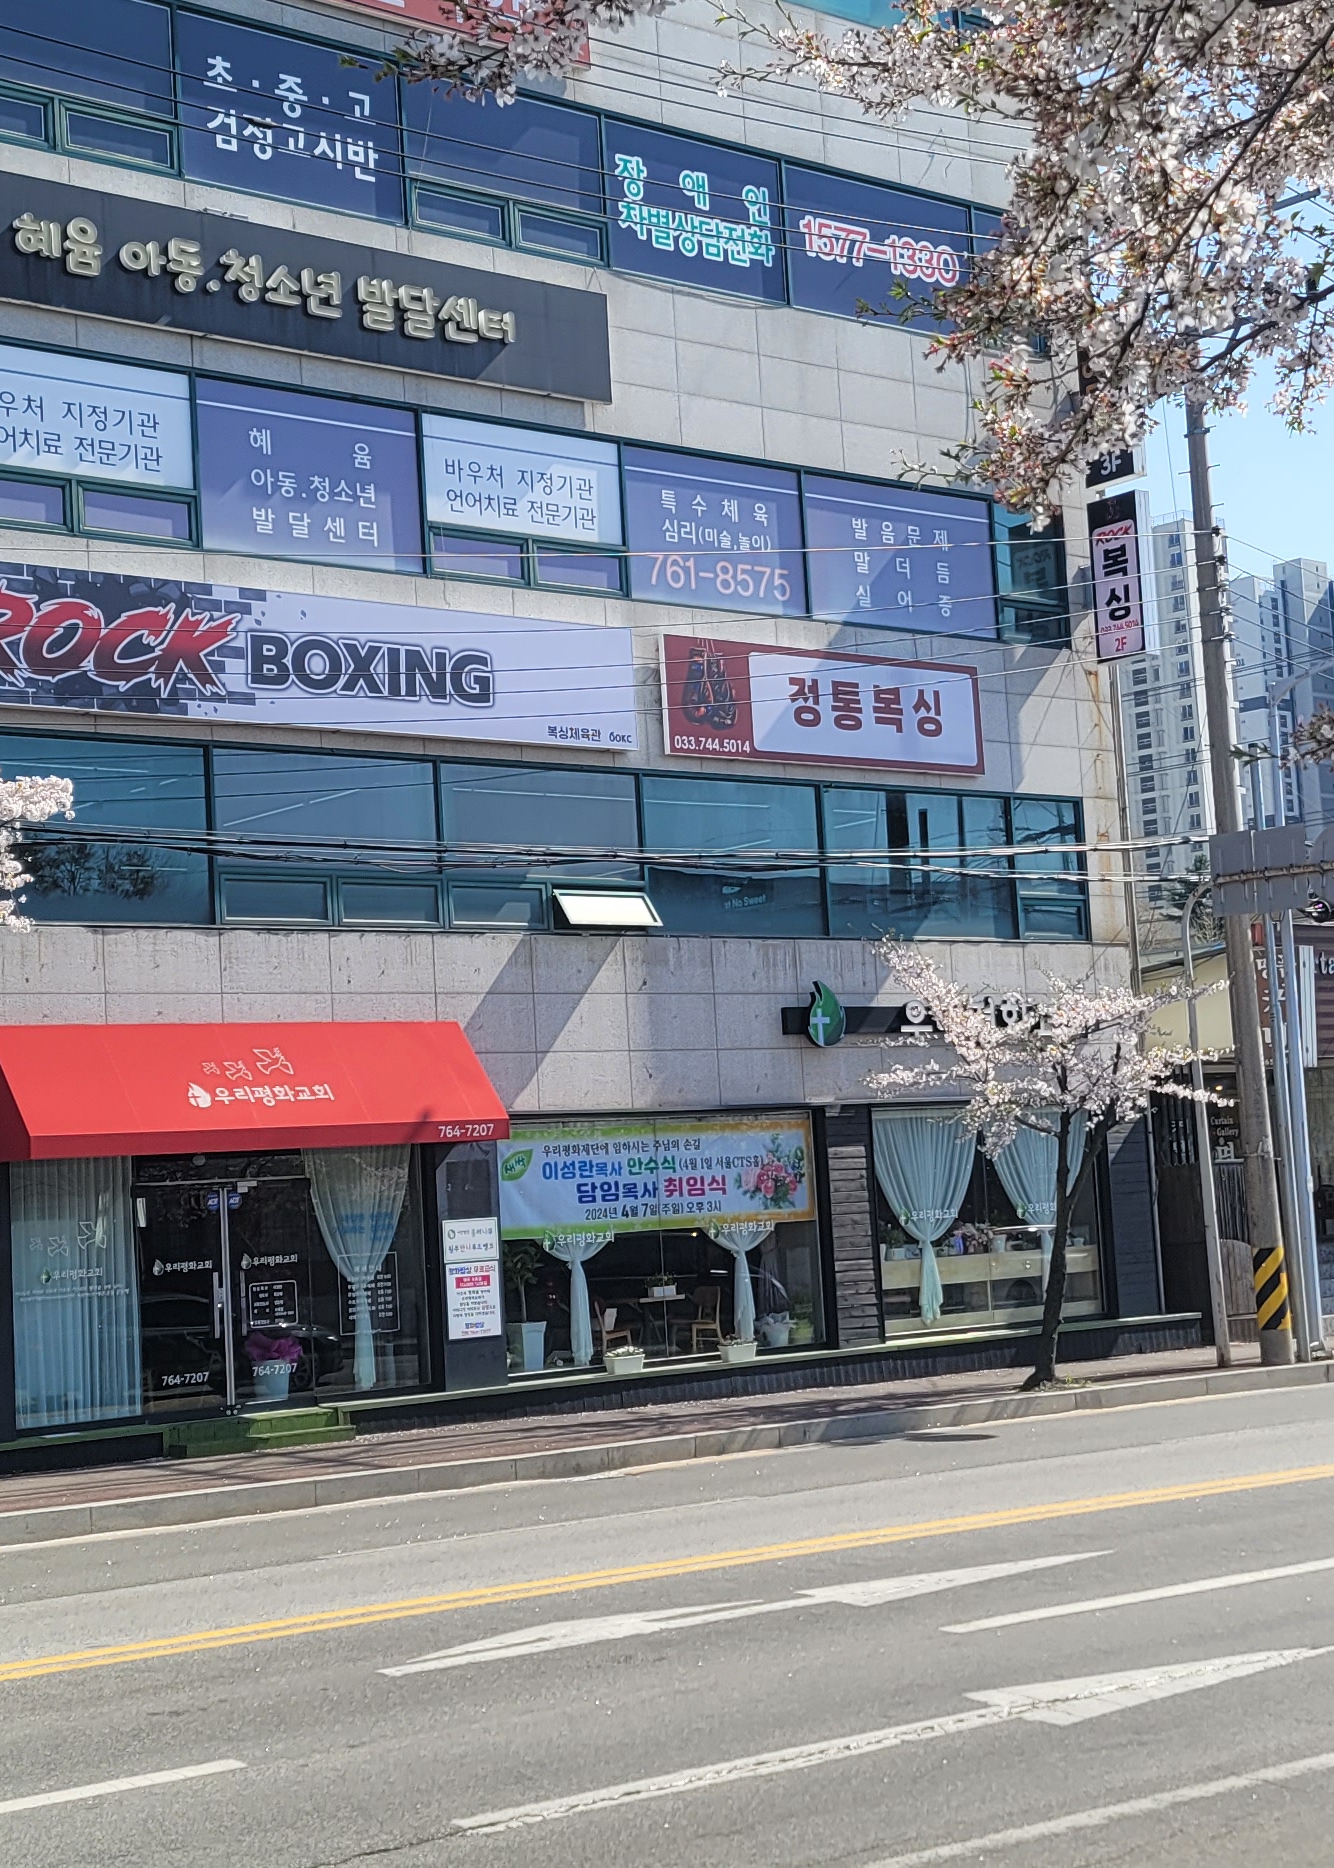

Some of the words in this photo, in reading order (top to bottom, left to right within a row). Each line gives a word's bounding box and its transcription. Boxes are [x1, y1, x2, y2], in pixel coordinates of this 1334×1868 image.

[206, 106, 380, 183] 검정고시반
[618, 198, 776, 268] 차별상담전화
[798, 215, 960, 287] 1577-1330
[357, 275, 517, 345] 발달센터
[61, 402, 160, 440] 지정기관
[73, 436, 163, 473] 전문기관
[1099, 454, 1122, 476] 3F
[250, 468, 377, 509] 아동.청소년
[444, 458, 505, 485] 바우처
[516, 469, 594, 503] 지정기관
[446, 488, 520, 520] 언어치료
[527, 499, 597, 533] 전문기관
[660, 489, 769, 528] 특수체육
[1095, 525, 1133, 547] ROCK
[649, 554, 792, 602] 761-8575
[1101, 542, 1132, 622] 복싱
[1114, 636, 1127, 652] 2F
[247, 632, 495, 708] BOXING
[788, 675, 945, 739] 정통복싱
[547, 725, 602, 742] 복싱체육관
[673, 734, 751, 755] 033.744.5014
[214, 1082, 336, 1107] 우리평화교회
[438, 1122, 496, 1139] 764-7207
[682, 1137, 701, 1151] 손길
[541, 1159, 623, 1181] 이성란목사
[627, 1154, 677, 1177] 안수식
[576, 1180, 659, 1205] 담임목사
[663, 1173, 728, 1199] 취임식
[584, 1205, 618, 1221] 2024년
[686, 1201, 705, 1215] 오후
[707, 1200, 722, 1213] 3시
[556, 1231, 615, 1247] 우리평화교회
[721, 1219, 775, 1236] 우리평화교회
[161, 1371, 210, 1387] 764-7207
[251, 1362, 298, 1378] 764-7207
